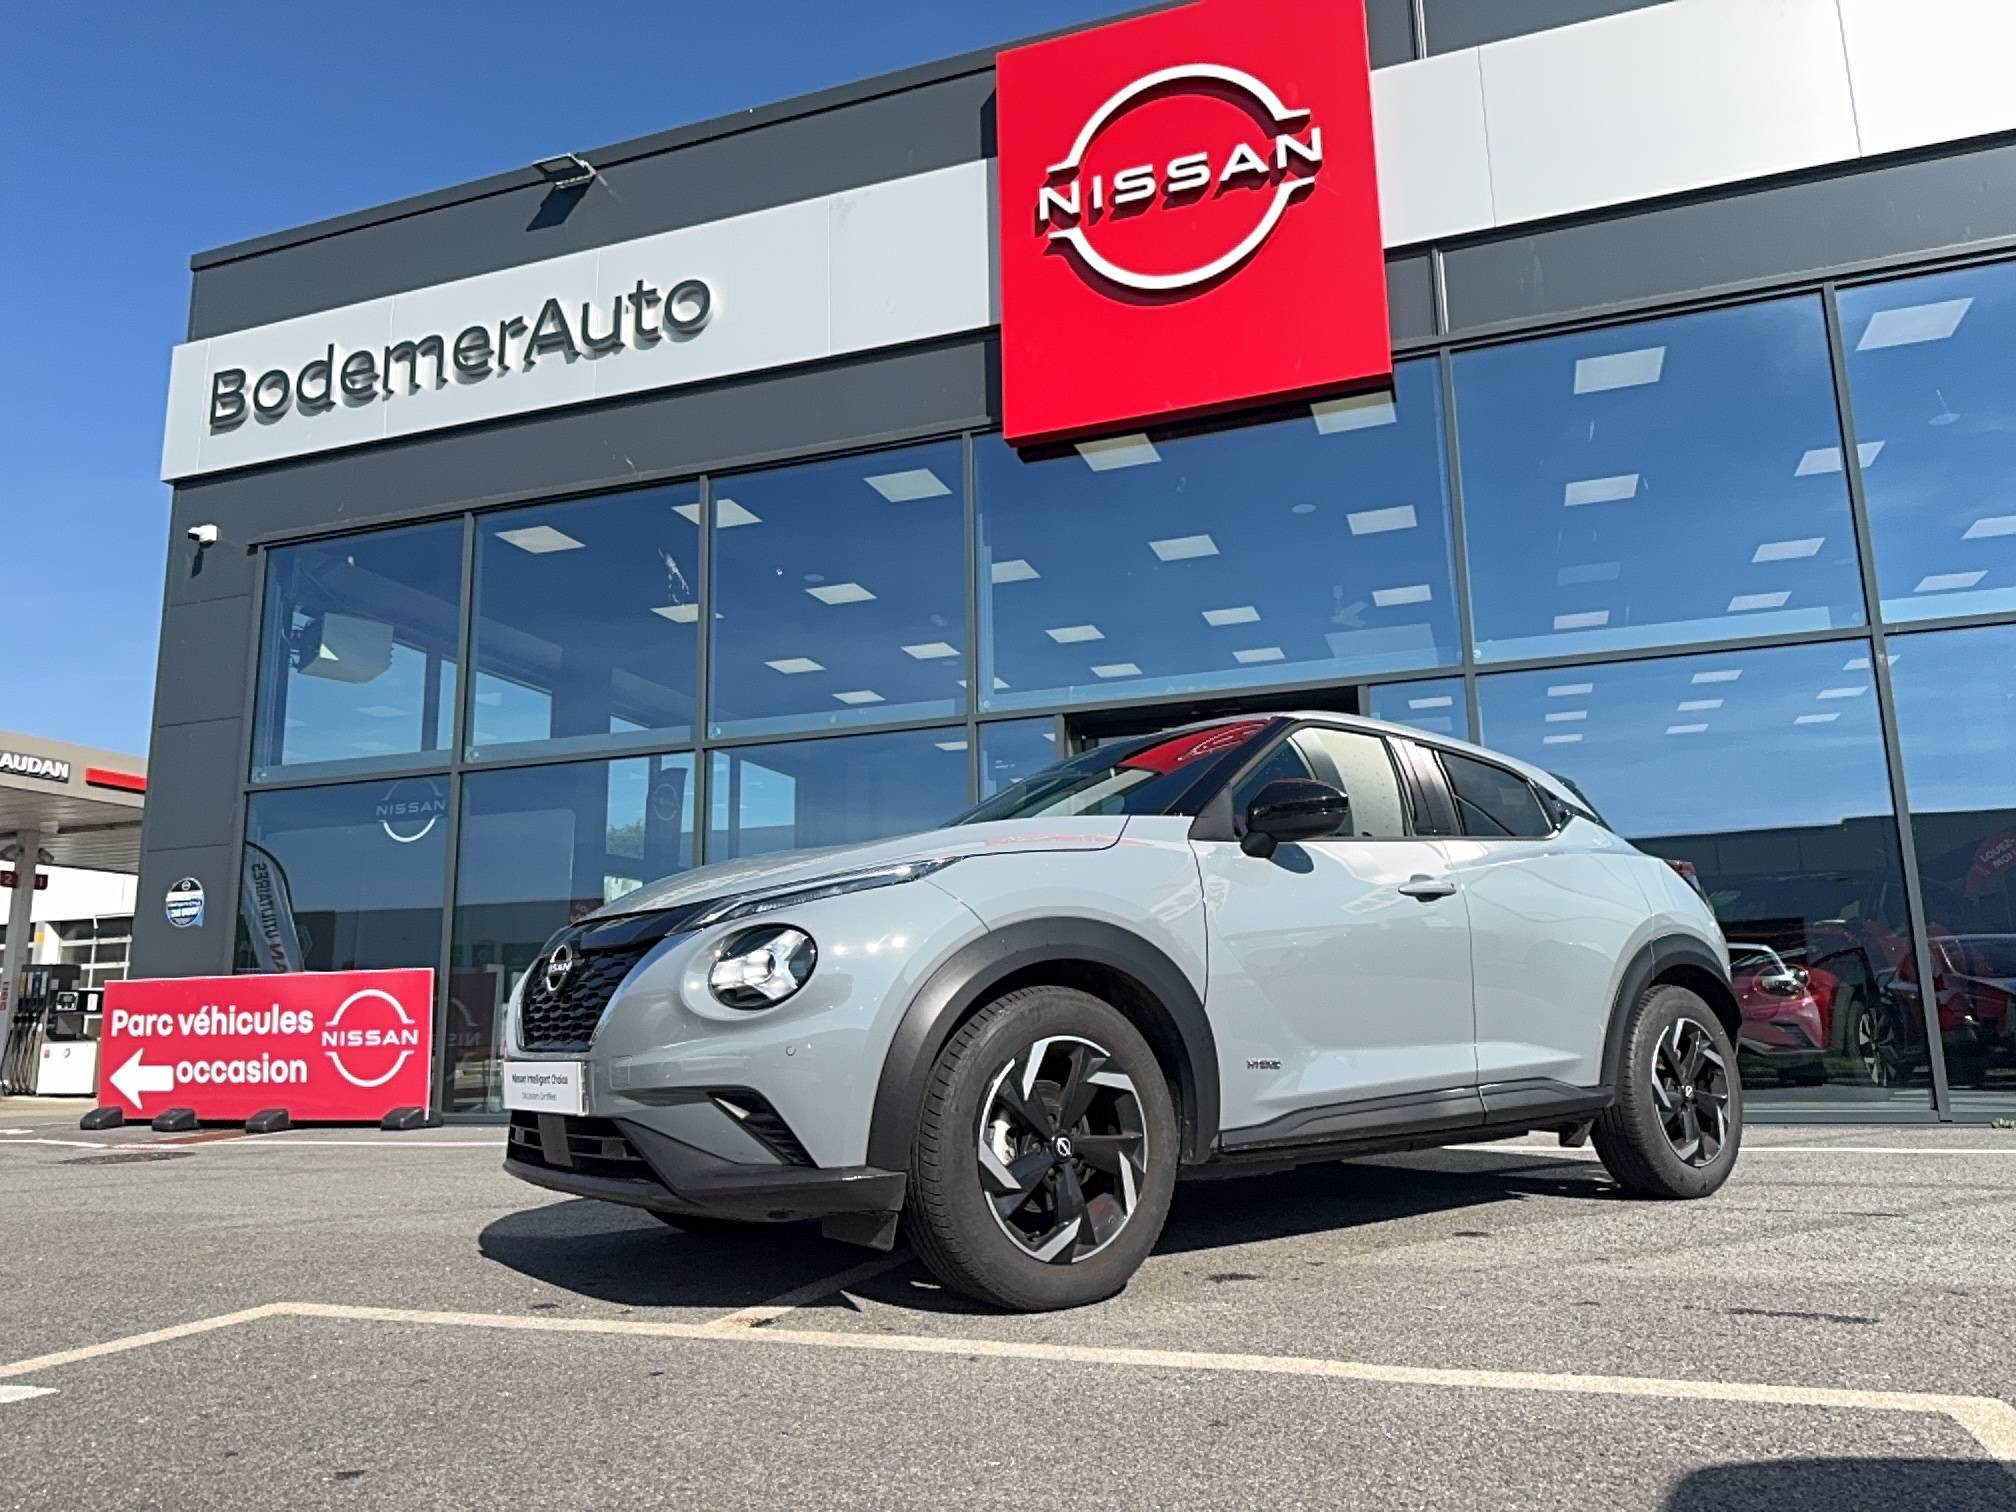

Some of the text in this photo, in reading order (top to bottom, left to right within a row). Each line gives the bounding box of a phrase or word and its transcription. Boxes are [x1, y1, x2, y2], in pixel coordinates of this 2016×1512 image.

[1037, 127, 1322, 221] NISSAN
[209, 278, 712, 432] BodemerAuto
[0, 752, 70, 779] AUDAN
[376, 800, 446, 816] NISSAN
[111, 1003, 314, 1037] Parc véhicules
[321, 1029, 419, 1047] NISSAN
[176, 1054, 307, 1084] occasion
